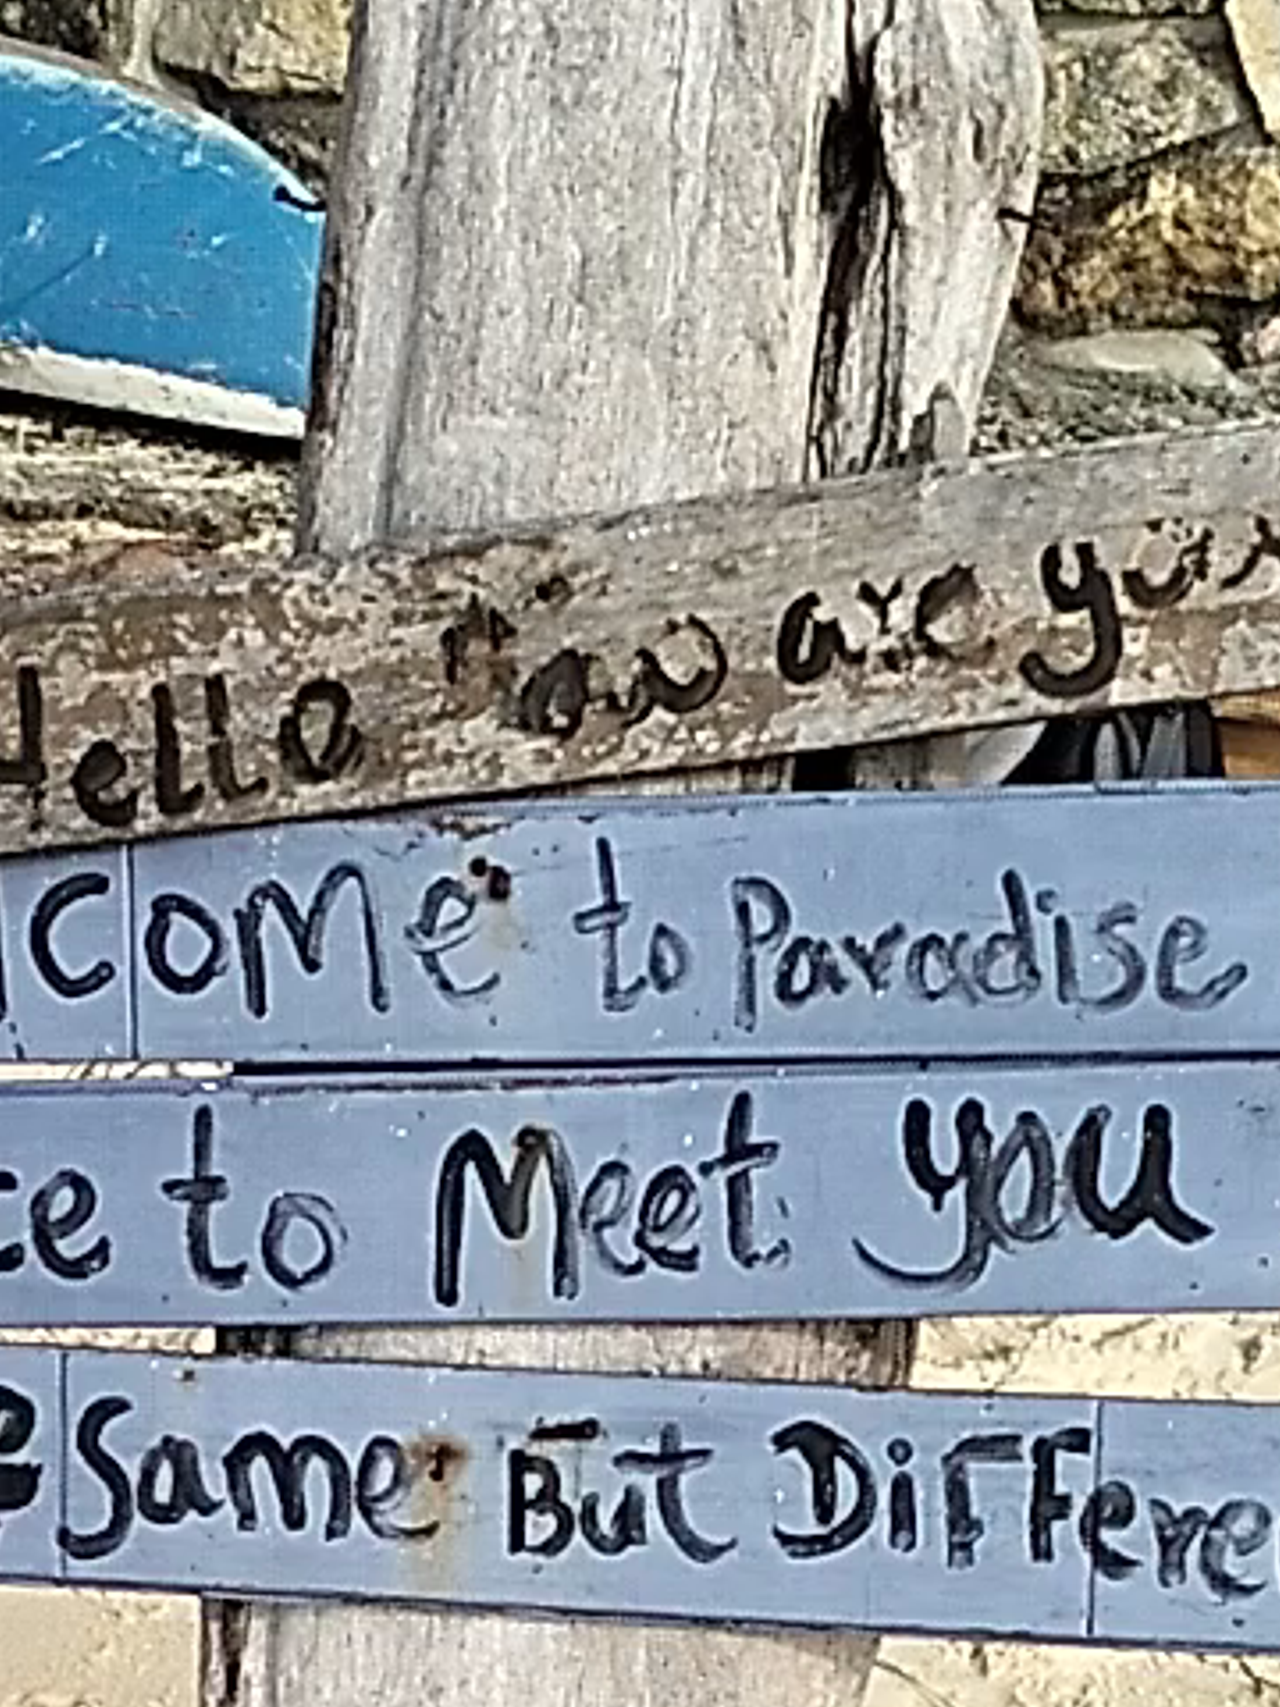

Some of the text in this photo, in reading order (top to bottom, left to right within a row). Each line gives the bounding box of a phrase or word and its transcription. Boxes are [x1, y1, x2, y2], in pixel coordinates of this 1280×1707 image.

[573, 836, 691, 1012] to
[730, 867, 1250, 1033] Paradise
[160, 1103, 348, 1291] to
[851, 1097, 1214, 1292] you
[57, 1396, 442, 1560] Same
[506, 1418, 738, 1563] But
